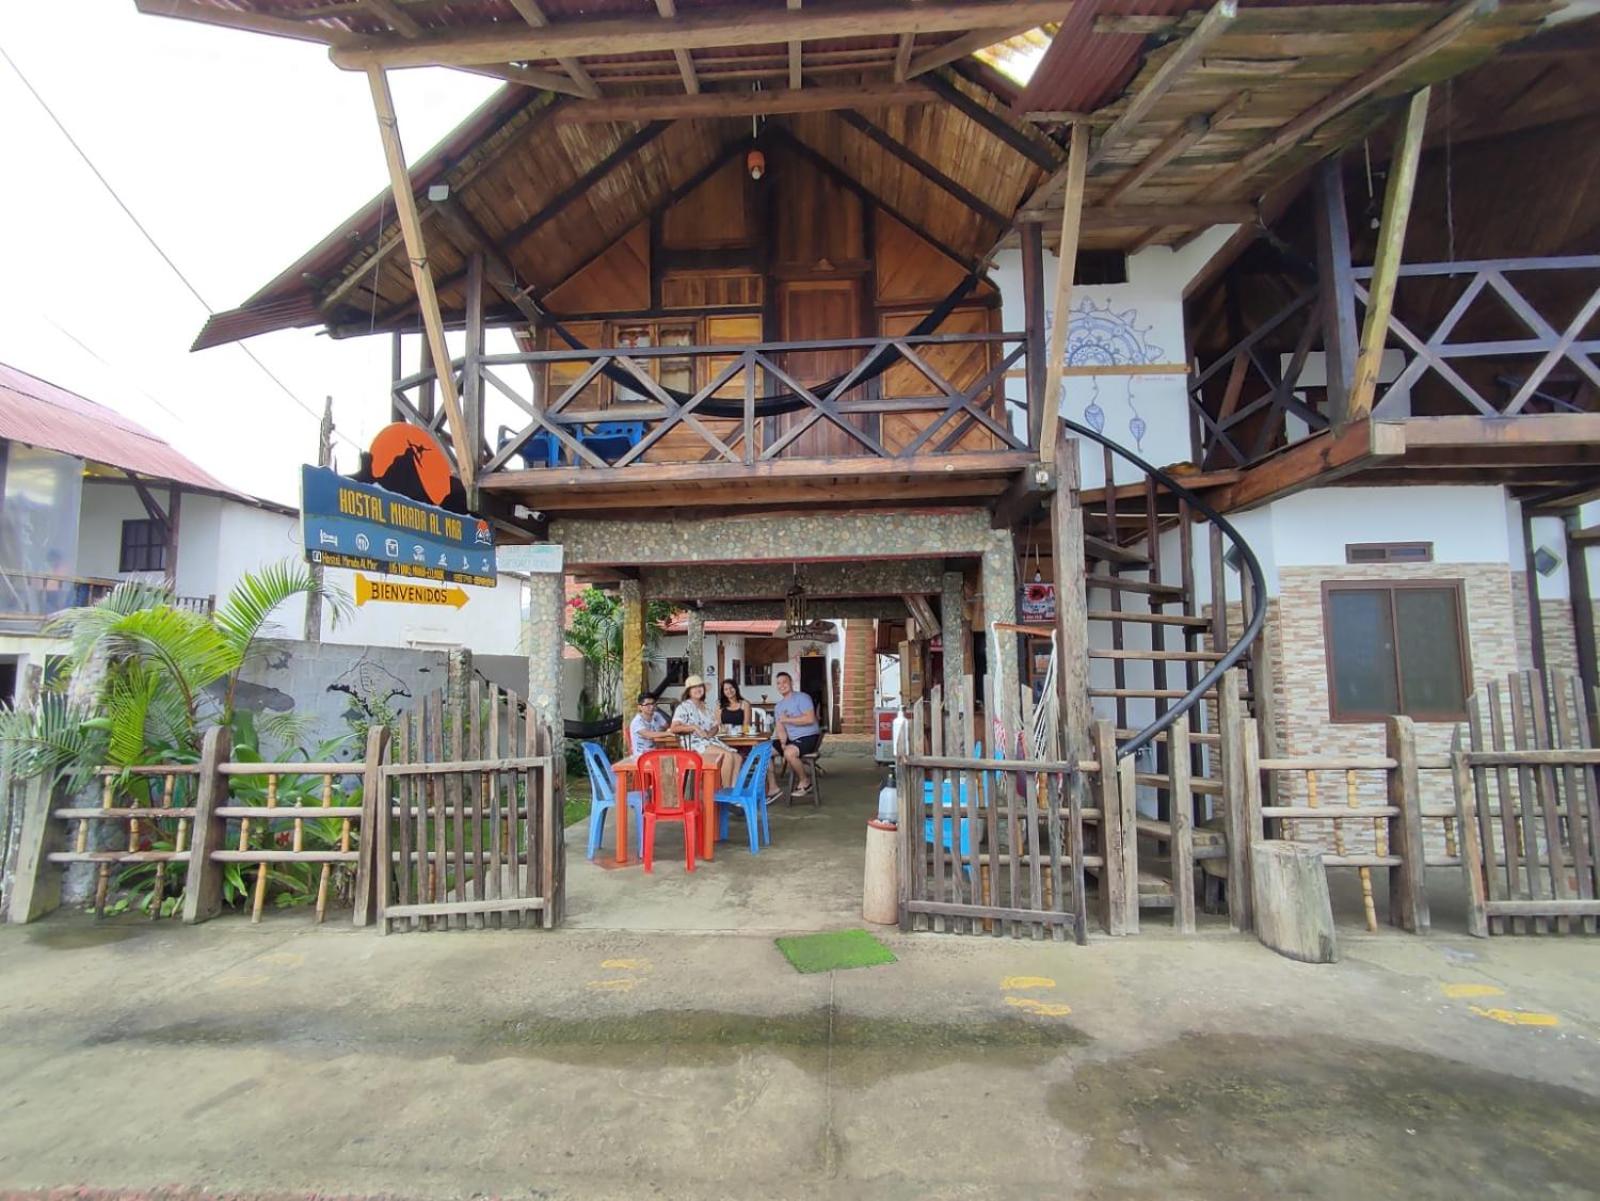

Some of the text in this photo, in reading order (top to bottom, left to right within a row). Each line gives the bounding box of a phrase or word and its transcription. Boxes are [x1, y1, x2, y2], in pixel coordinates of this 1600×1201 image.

[339, 487, 463, 541] HOSTAL MIRADA AL MAR
[371, 582, 448, 603] BIENVENIDOS
